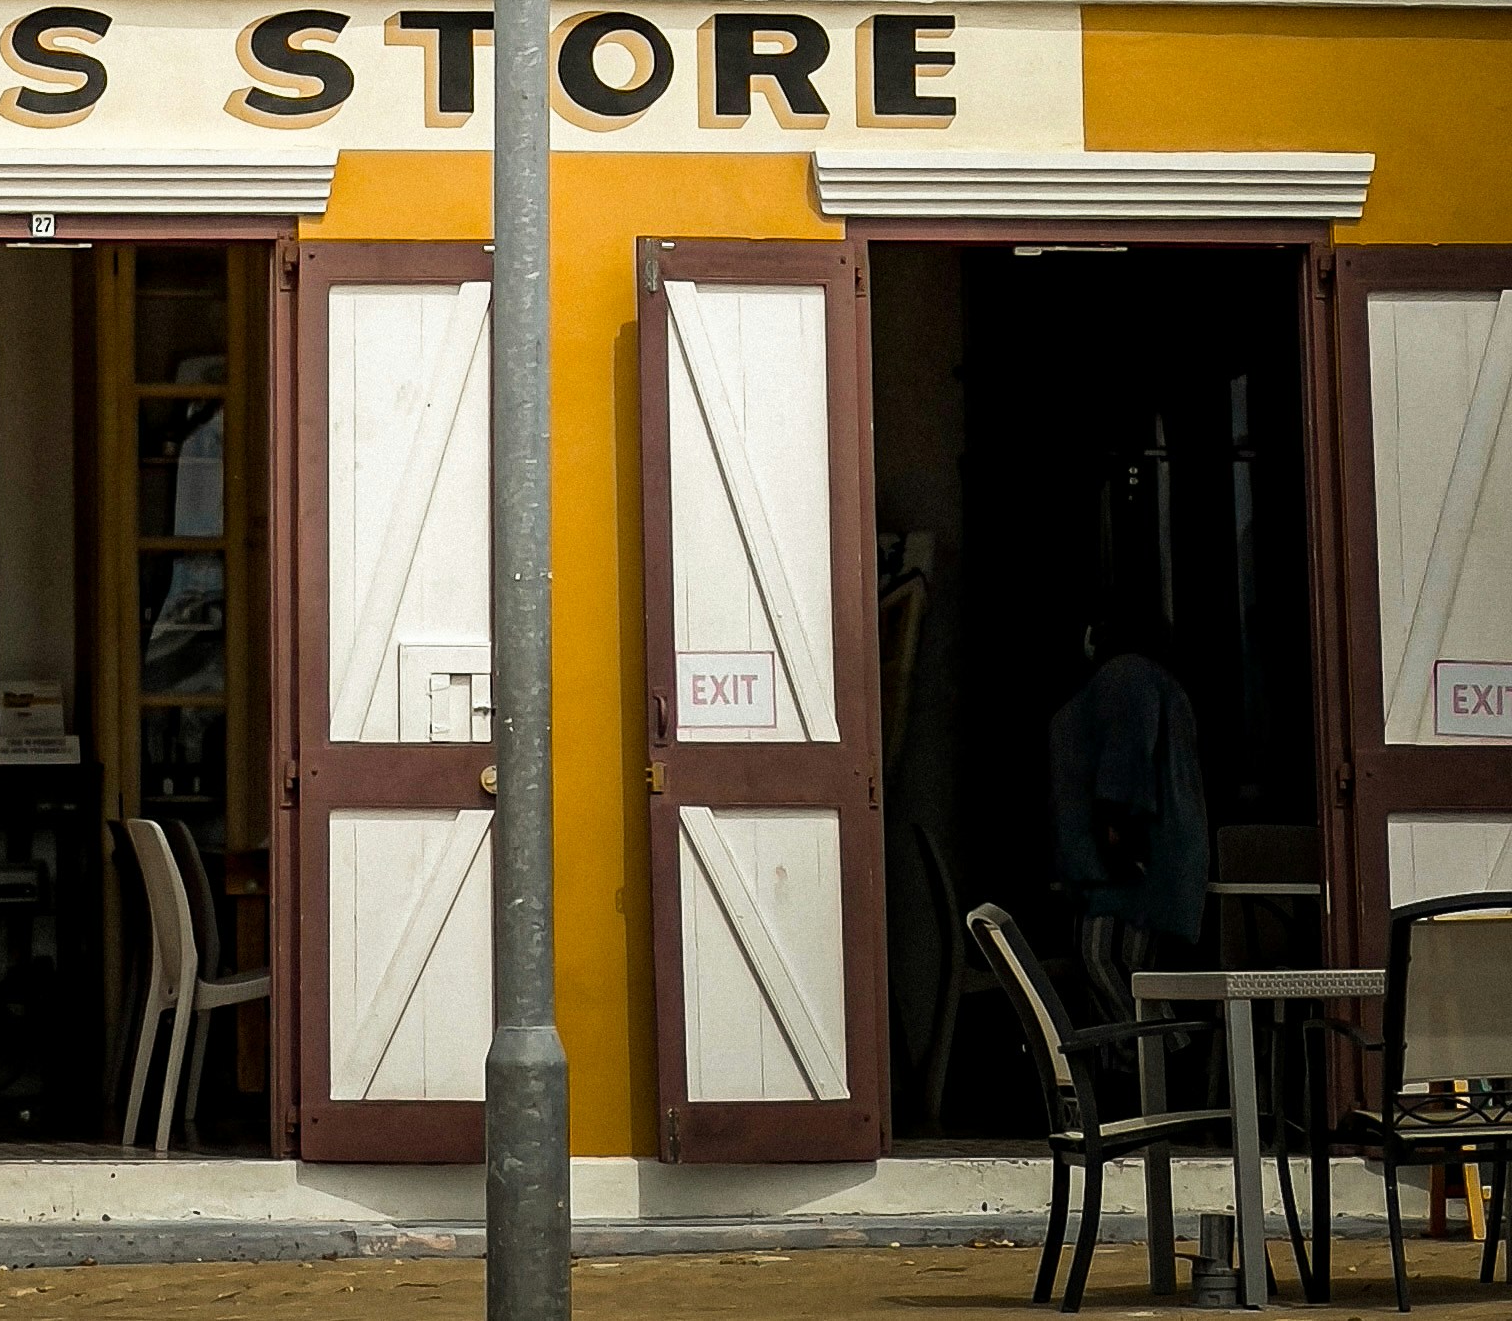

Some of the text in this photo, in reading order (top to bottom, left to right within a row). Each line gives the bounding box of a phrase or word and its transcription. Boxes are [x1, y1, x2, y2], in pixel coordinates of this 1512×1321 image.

[223, 9, 956, 132] STORE
[35, 217, 52, 232] 27
[692, 674, 759, 705] EXIT
